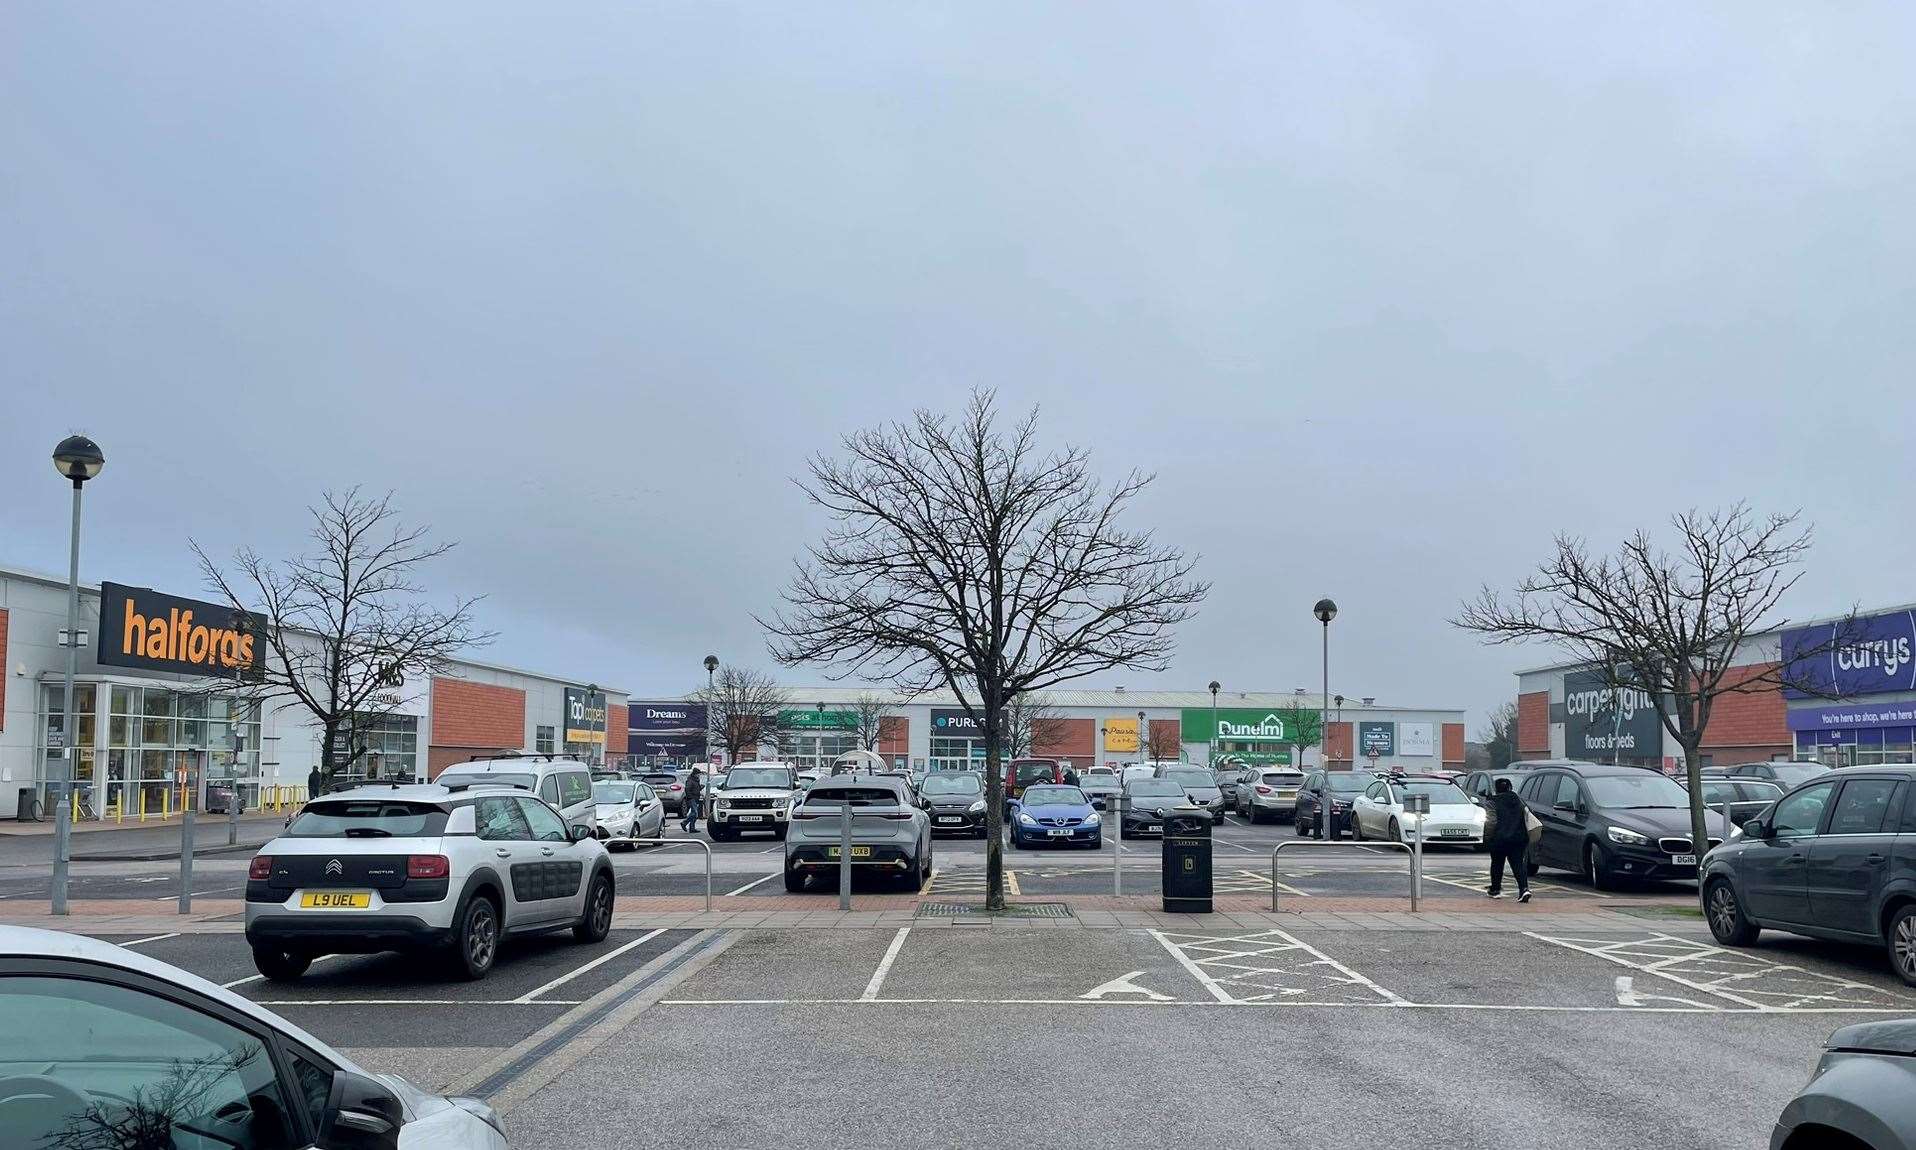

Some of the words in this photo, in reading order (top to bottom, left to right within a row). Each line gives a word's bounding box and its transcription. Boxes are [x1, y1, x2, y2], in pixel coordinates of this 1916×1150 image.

[123, 598, 254, 669] halfords
[1838, 636, 1911, 676] currys
[585, 706, 606, 722] capets
[646, 709, 687, 719] Dreams
[1822, 713, 1839, 724] You're
[1840, 713, 1854, 723] here
[1854, 713, 1862, 722] to
[1880, 710, 1897, 721] we're
[1898, 709, 1913, 720] here
[1218, 720, 1281, 735] Dunelm
[1677, 856, 1695, 864] DG16
[313, 893, 330, 906] L9
[333, 892, 356, 906] UEL
